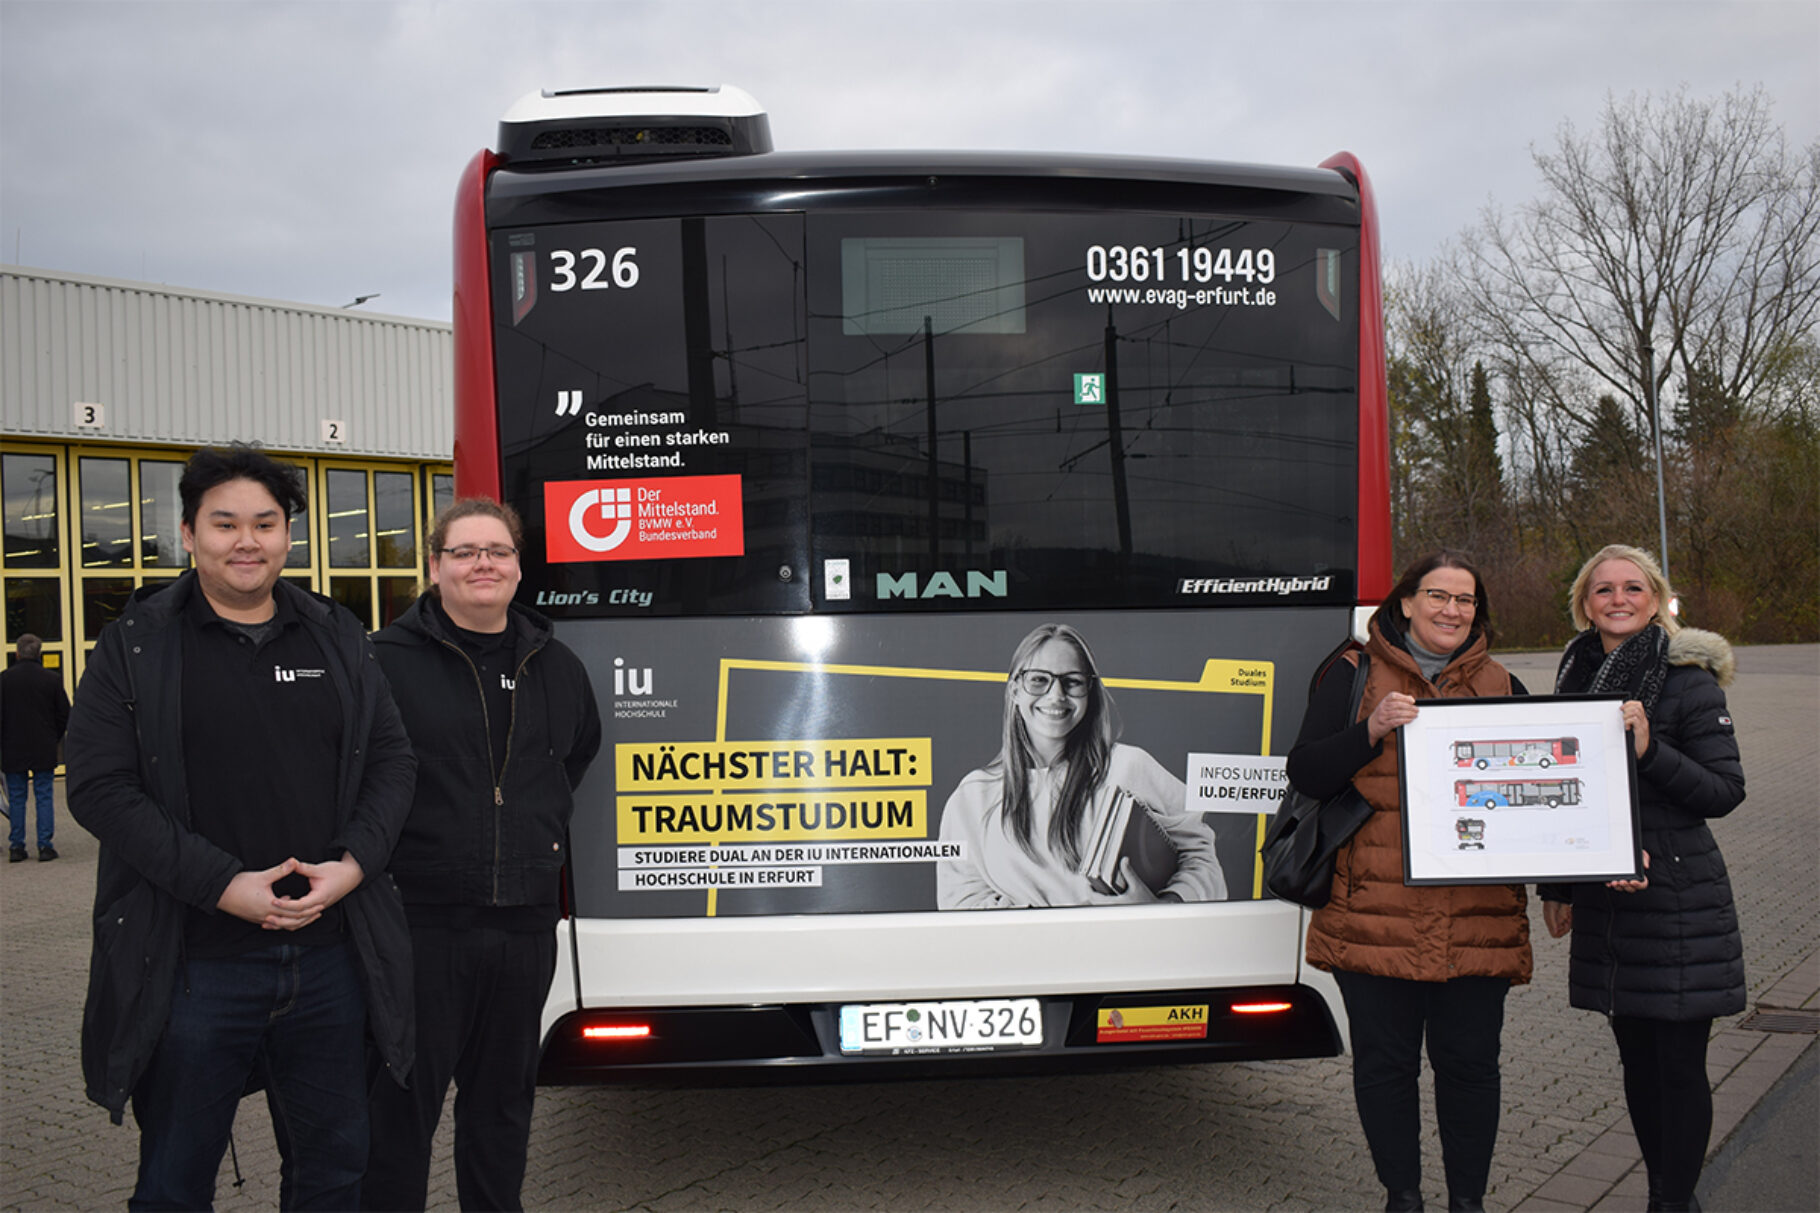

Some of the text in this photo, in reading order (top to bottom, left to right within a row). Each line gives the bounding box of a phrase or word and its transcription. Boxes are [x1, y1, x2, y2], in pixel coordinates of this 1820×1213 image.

[550, 247, 640, 292] 326
[1086, 245, 1276, 284] 0361 19449
[1088, 286, 1277, 310] www.evag-erfurt.de
[84, 406, 95, 424] 3
[585, 411, 685, 427] Gemeinsam
[329, 424, 338, 440] 2
[585, 429, 729, 448] für einen starken
[586, 451, 686, 470] Mittelstand.
[637, 487, 661, 502] Der
[638, 499, 719, 517] Mittelstand.
[639, 517, 695, 529] BVMW e.V.
[639, 528, 717, 542] Bundesverband
[876, 570, 1007, 600] MAN
[1181, 576, 1330, 595] EfficientHybrid
[536, 589, 653, 607] Lion's City
[274, 665, 296, 682] iu
[500, 673, 516, 690] iu
[614, 657, 653, 696] iu
[1238, 668, 1267, 678] Duales
[1230, 678, 1266, 687] Studium
[614, 699, 679, 709] INTERNATIONALE
[614, 710, 667, 718] HOCHSCHULE
[632, 745, 917, 781] NÄCHSTER HALT:
[1200, 766, 1287, 782] INFOS UNTER
[1199, 786, 1287, 801] IU.DE/ERFUR
[632, 800, 913, 833] TRAUMSTUDIUM
[634, 845, 961, 864] STUDIERE DUAL AN DER IU INTERNATIONALEN
[635, 870, 815, 886] HOCHSCHULE IN ERFURT
[1167, 1007, 1203, 1021] AKH
[863, 1006, 1036, 1042] EF NV 326
